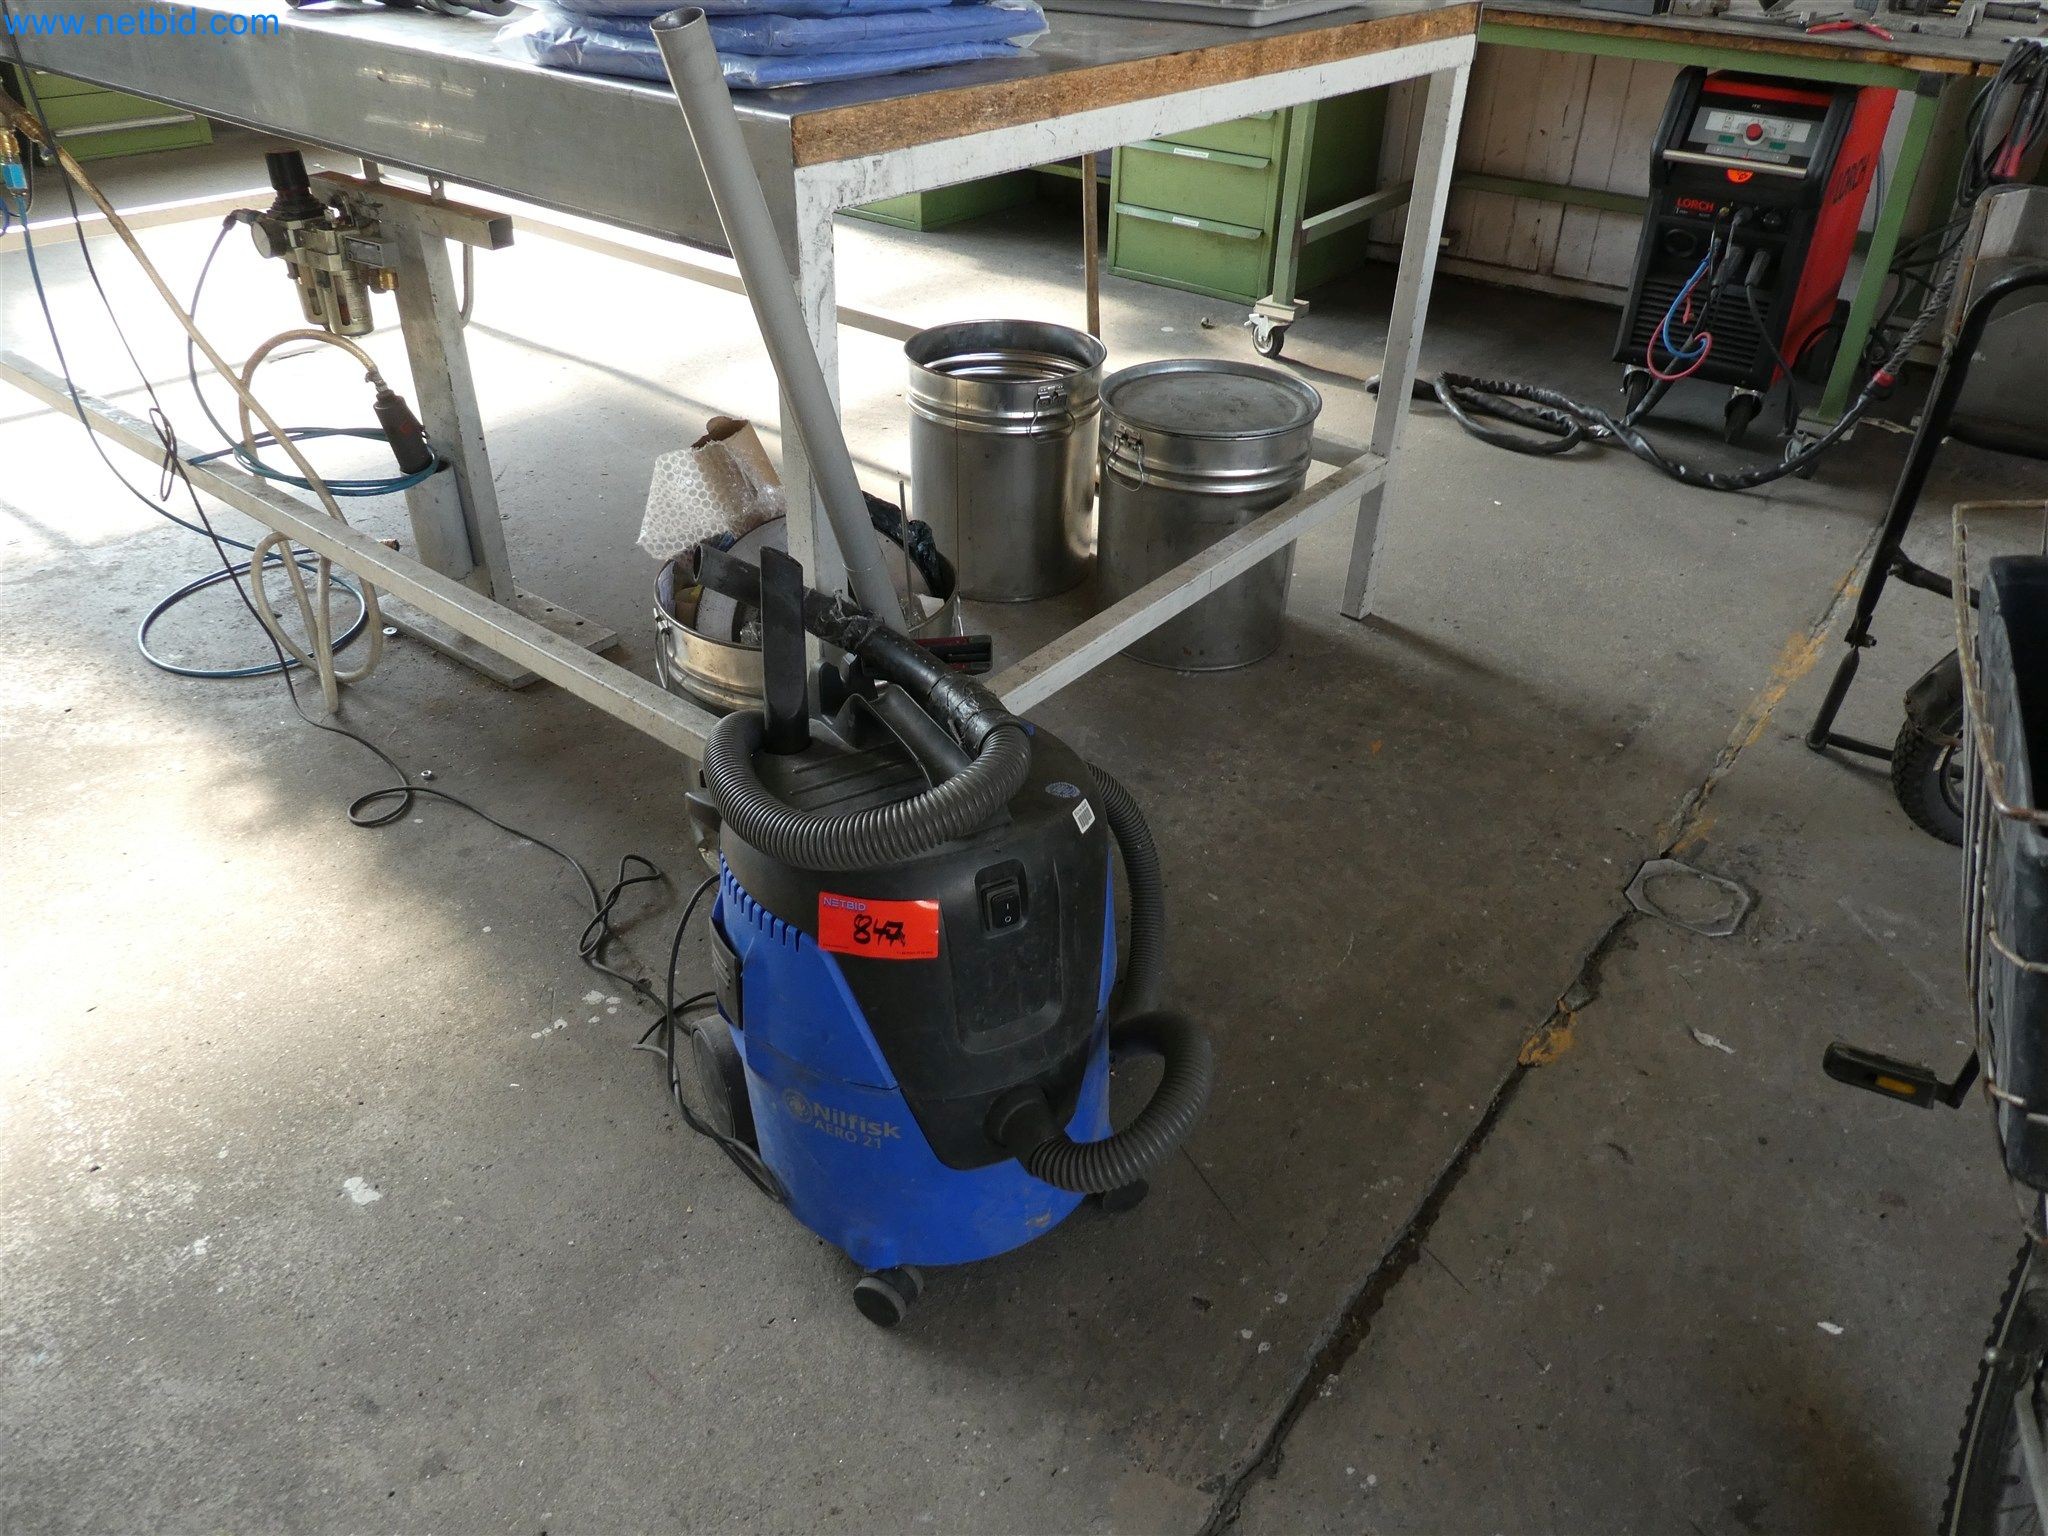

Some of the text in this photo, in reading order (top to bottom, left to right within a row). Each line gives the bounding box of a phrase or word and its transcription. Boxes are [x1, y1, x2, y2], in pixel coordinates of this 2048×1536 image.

[1676, 197, 1714, 212] LORCH
[823, 897, 867, 911] NETBID
[813, 1102, 900, 1139] Nilfisk
[814, 1120, 881, 1149] AERO 21
